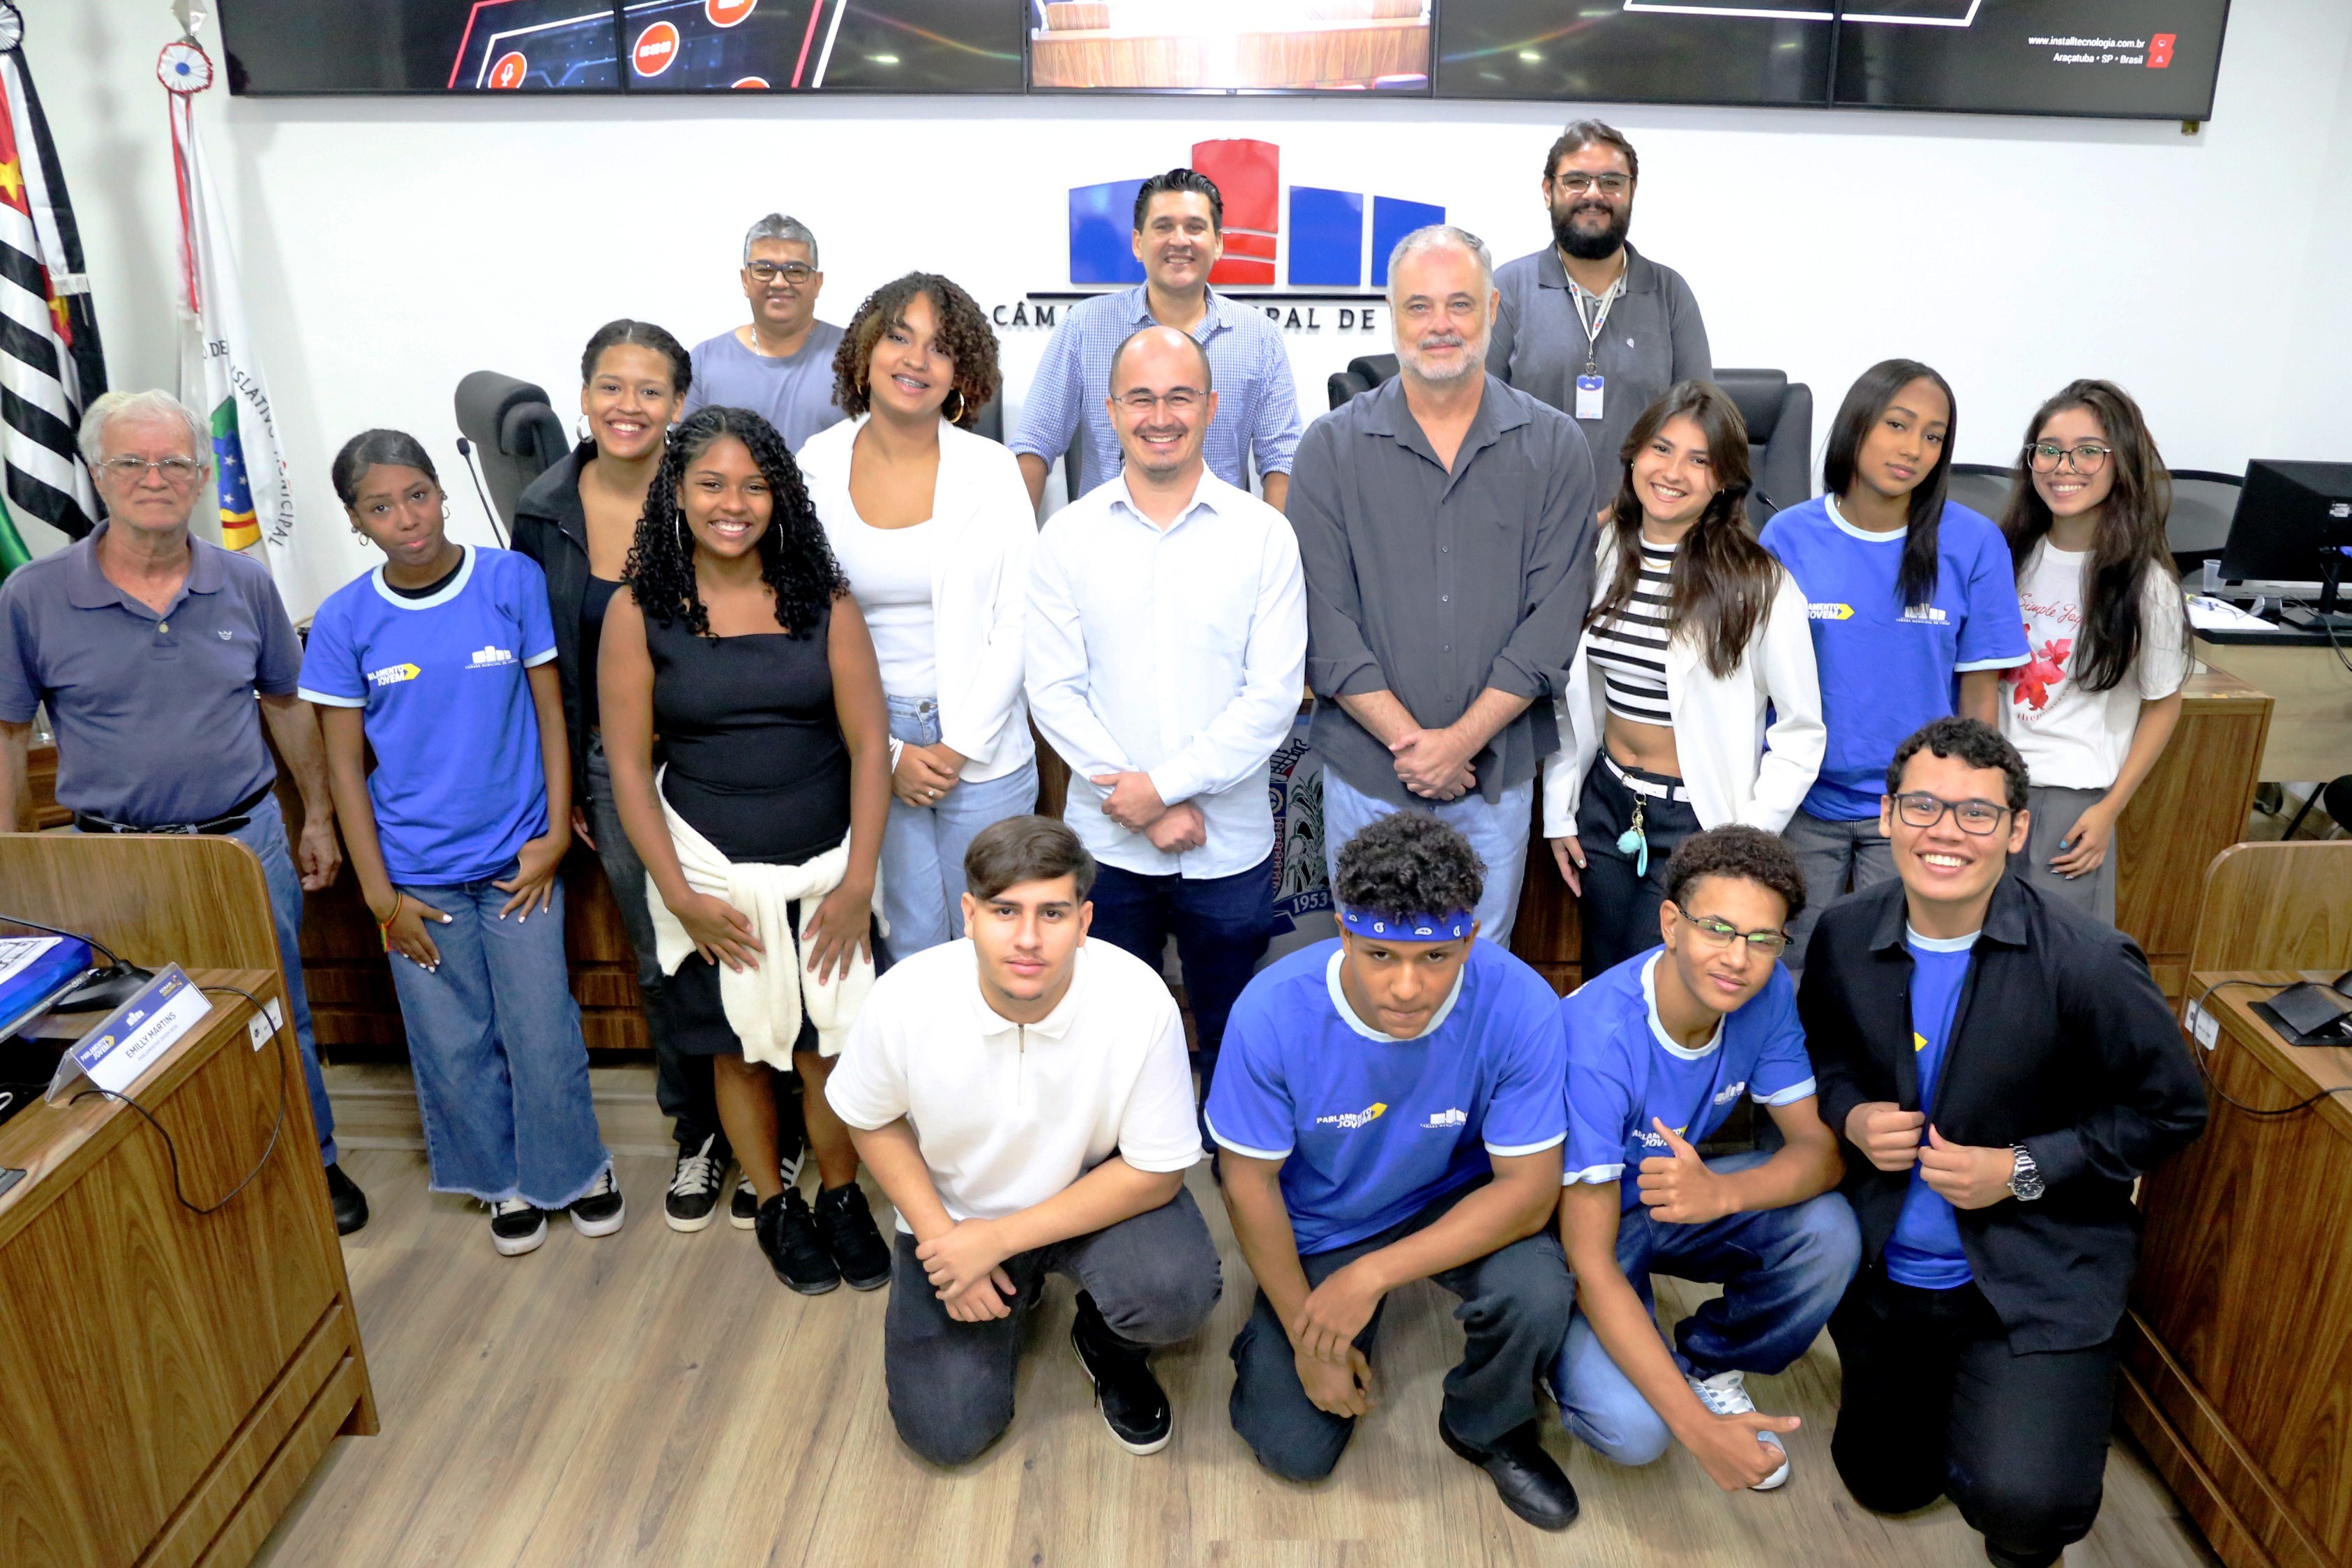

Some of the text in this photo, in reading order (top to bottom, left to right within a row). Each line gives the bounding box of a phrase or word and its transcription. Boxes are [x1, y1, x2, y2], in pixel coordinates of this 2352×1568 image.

[2028, 36, 2145, 49] www.installtecnologia.com.br
[2053, 52, 2143, 64] Araçatuba SP Brasil
[993, 301, 1375, 329] CÂM PAL DE
[209, 340, 229, 357] DE
[1808, 603, 1839, 612] AMENTO
[1808, 610, 1839, 619] OVEM
[367, 664, 405, 681] RLAMENTO
[377, 672, 405, 686] JOVEM
[1293, 892, 1329, 913] 1953
[125, 1034, 150, 1058] EMILLY
[147, 1011, 176, 1039] MARTINS
[93, 1041, 111, 1061] JOVEM
[1316, 1107, 1372, 1124] PARLAMENTO
[1336, 1113, 1372, 1129] JOVEM
